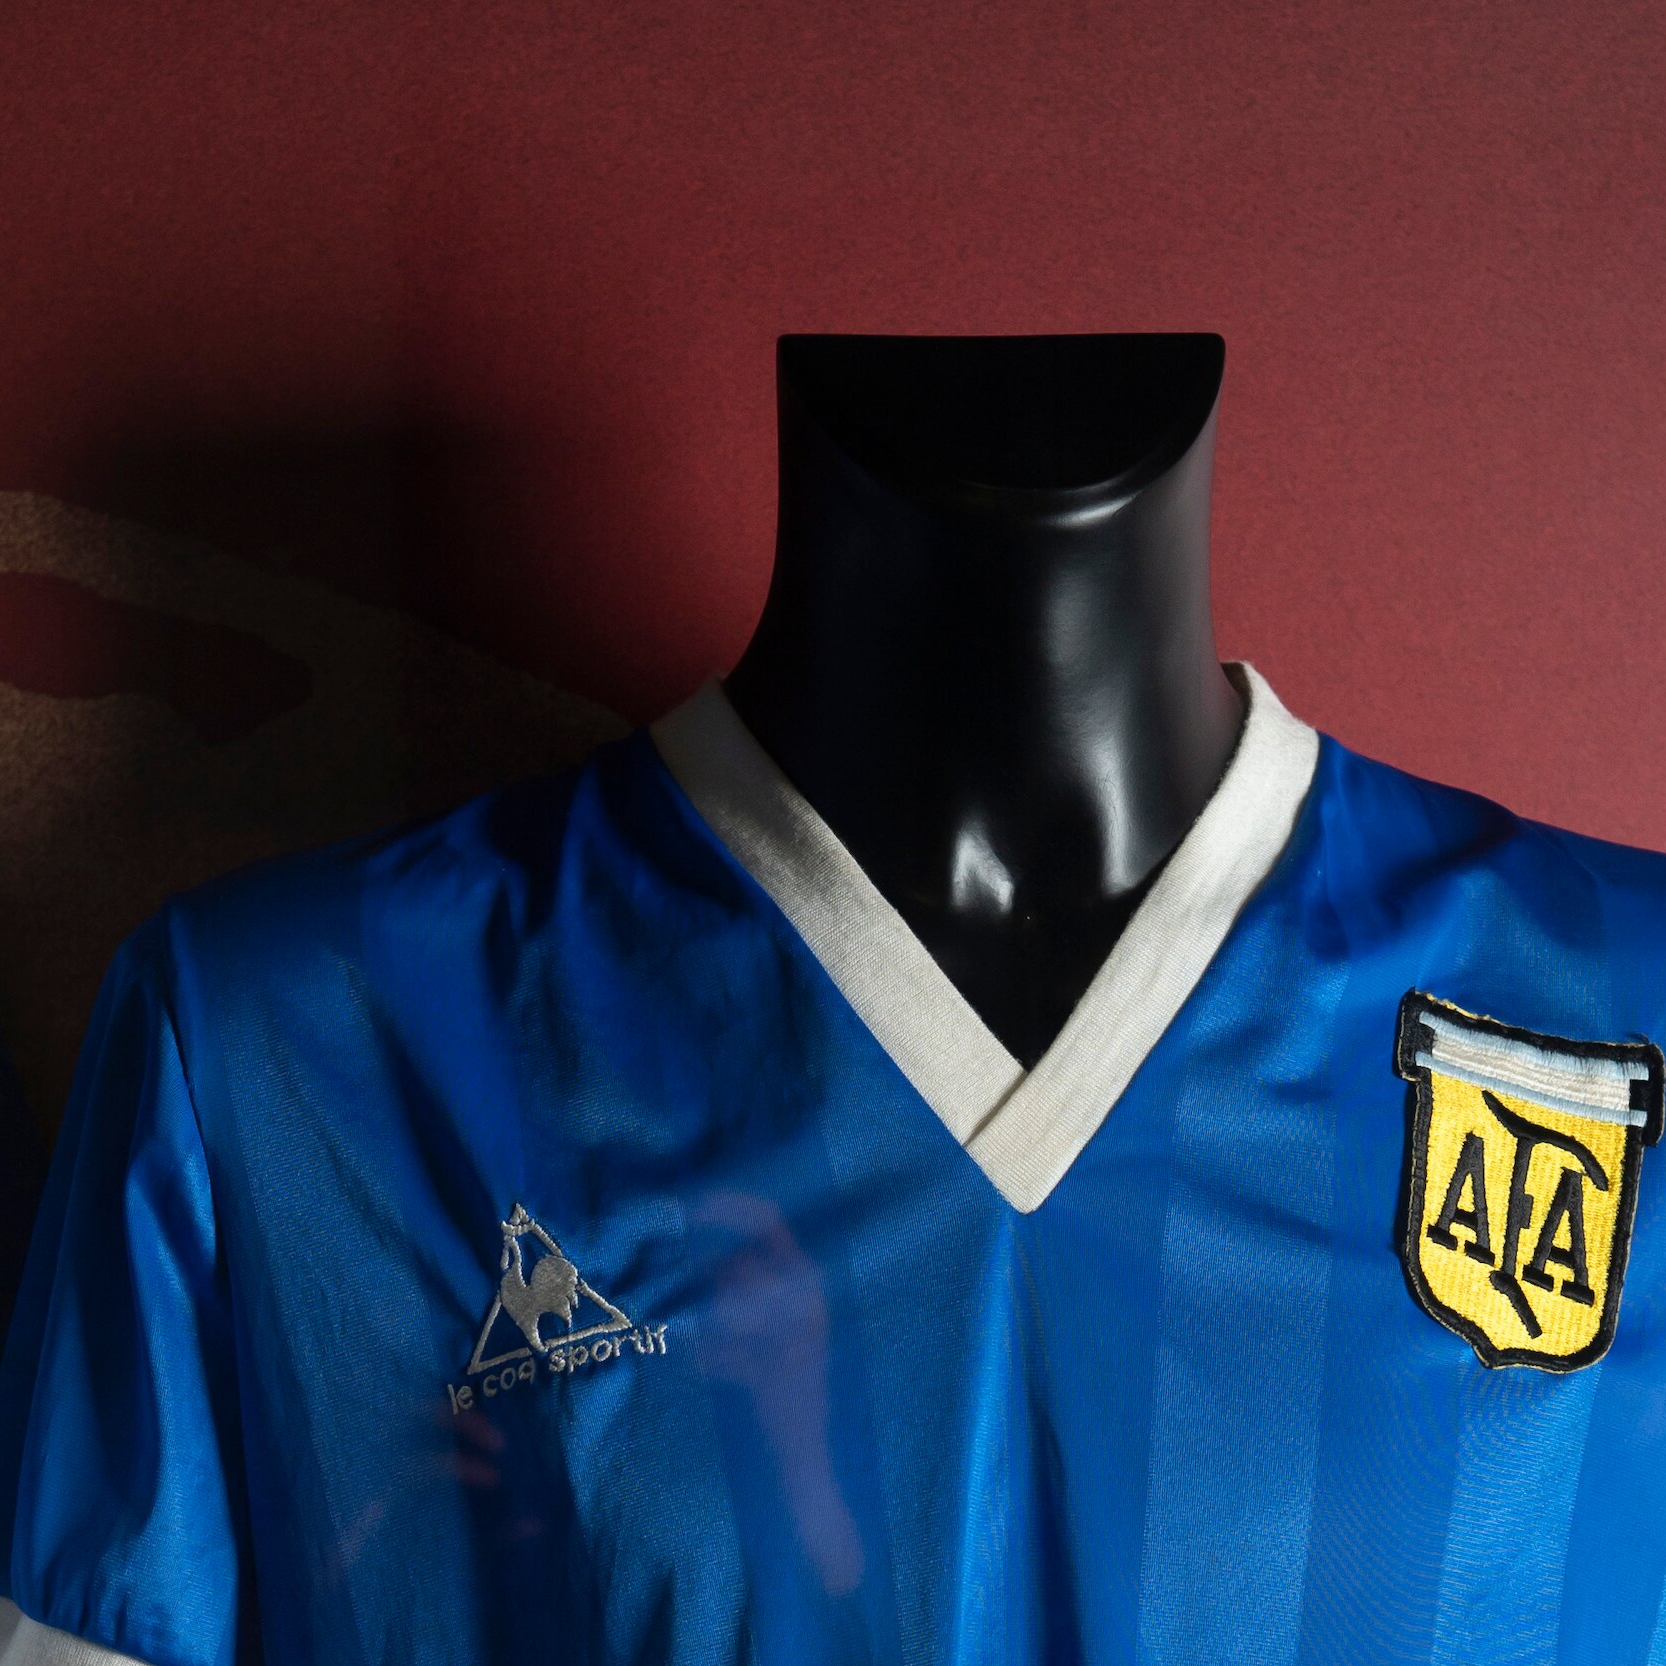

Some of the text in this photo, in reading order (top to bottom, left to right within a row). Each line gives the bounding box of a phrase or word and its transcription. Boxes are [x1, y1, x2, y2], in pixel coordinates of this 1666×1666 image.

[1427, 1090, 1609, 1339] AFA
[448, 1323, 669, 1415] le coq sportif
